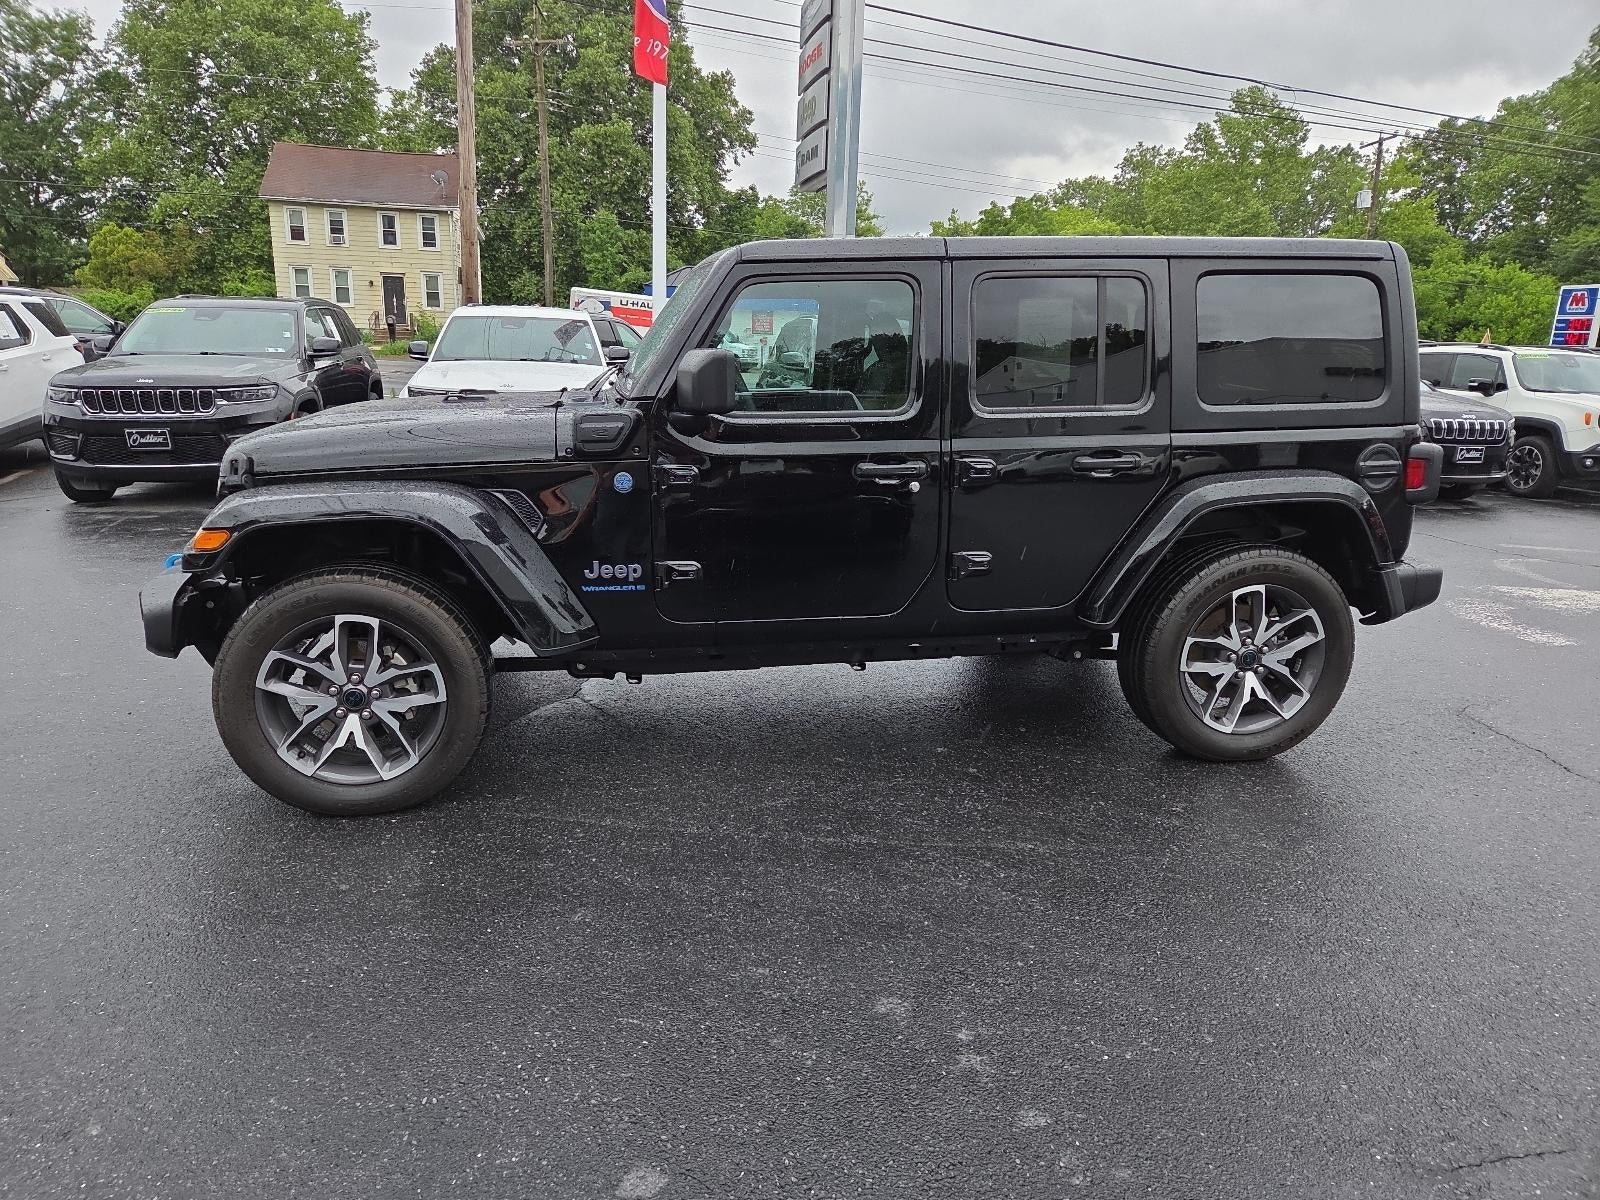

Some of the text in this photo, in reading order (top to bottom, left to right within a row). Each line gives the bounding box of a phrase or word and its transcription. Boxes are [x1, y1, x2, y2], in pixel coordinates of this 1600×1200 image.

[801, 144, 819, 168] RAM
[620, 299, 653, 309] U-HAU
[584, 560, 642, 581] Jeep
